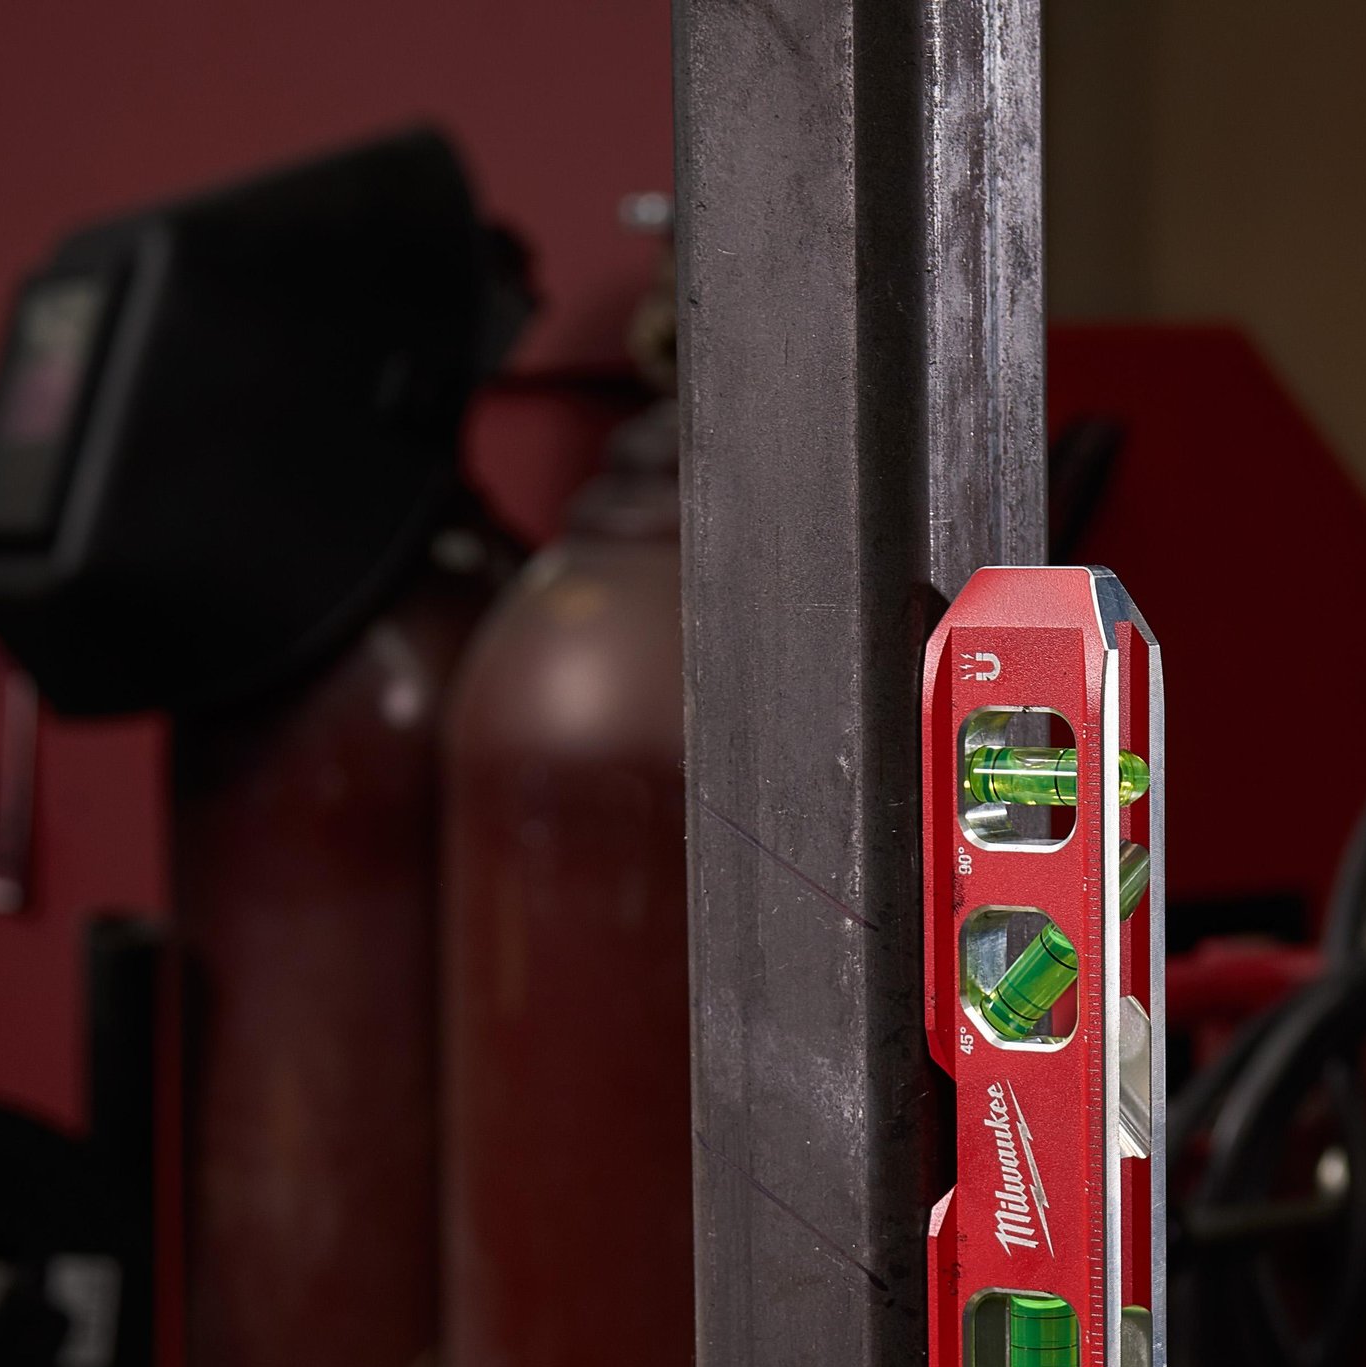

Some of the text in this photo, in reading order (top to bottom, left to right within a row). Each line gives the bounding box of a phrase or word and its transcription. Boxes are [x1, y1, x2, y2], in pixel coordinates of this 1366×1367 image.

[958, 846, 972, 875] 90°
[960, 1026, 974, 1055] 45°
[984, 1081, 1039, 1257] Milwaukee
